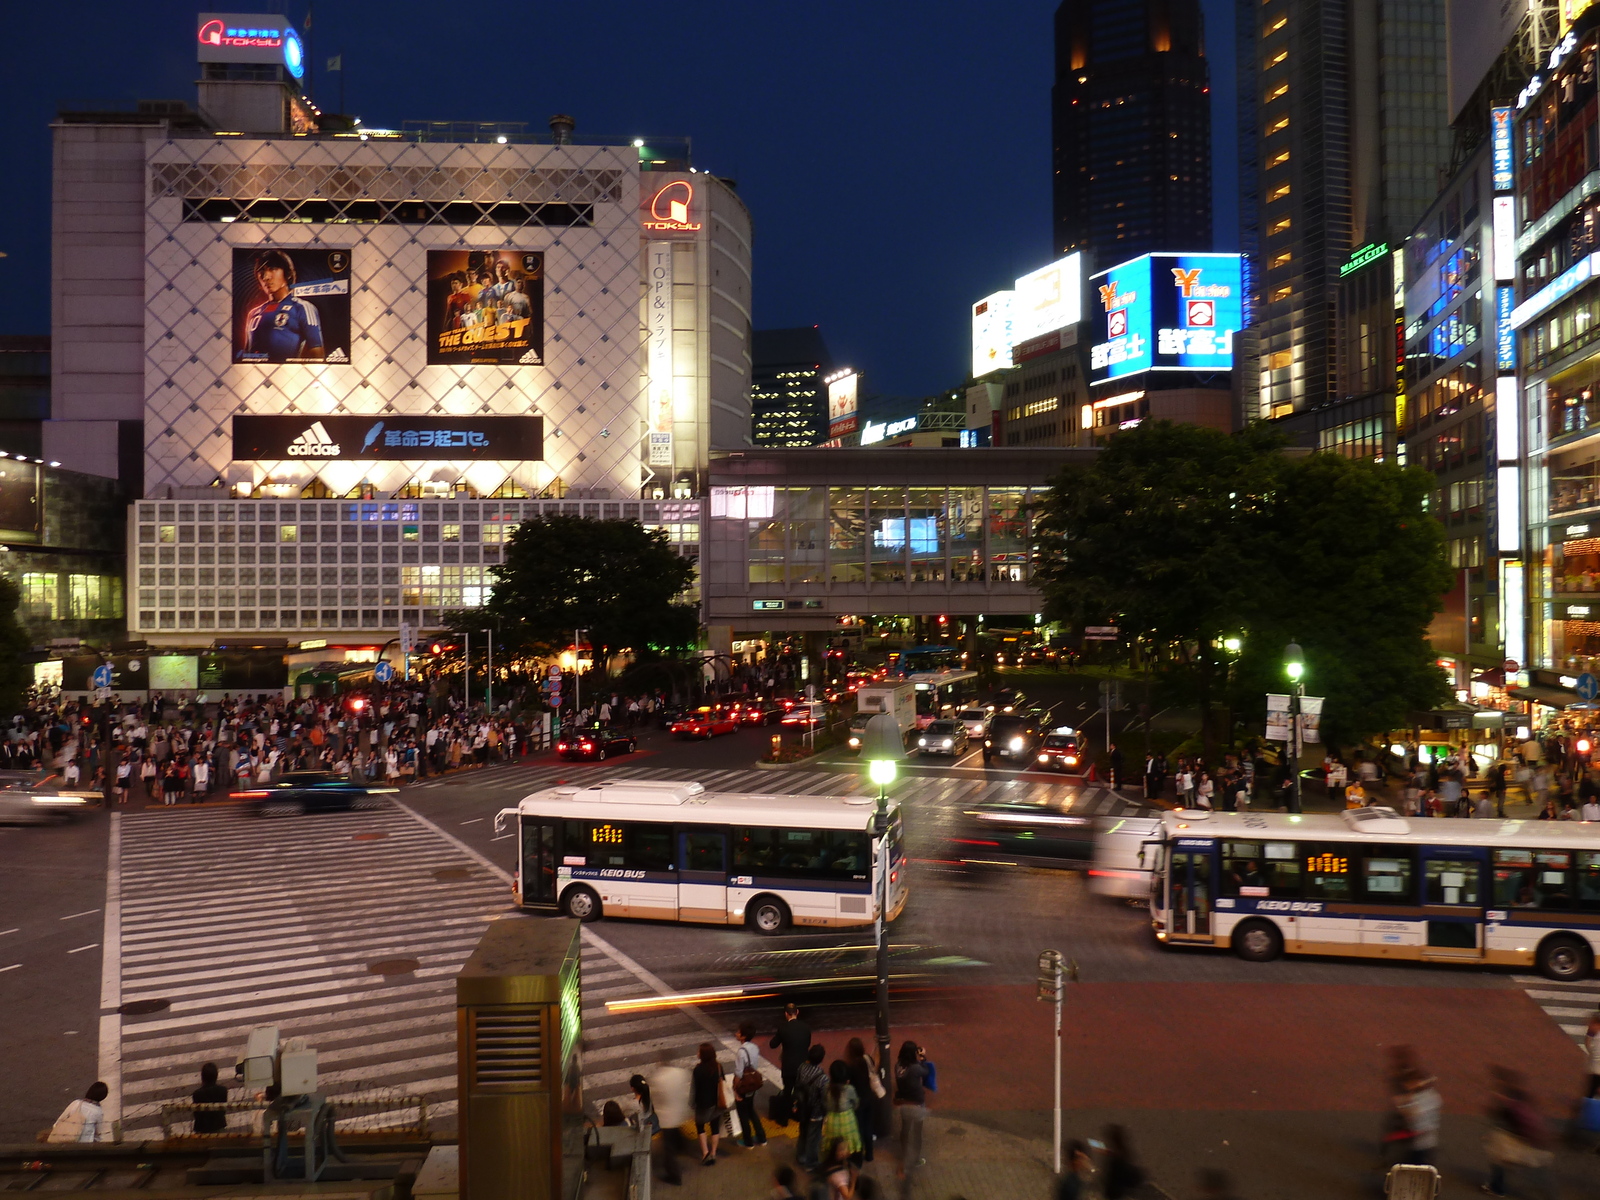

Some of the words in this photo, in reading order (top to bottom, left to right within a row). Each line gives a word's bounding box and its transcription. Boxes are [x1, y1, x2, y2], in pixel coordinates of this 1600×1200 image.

[221, 38, 281, 46] TOKYU
[643, 222, 701, 230] TOKYU
[1340, 256, 1365, 274] MARK
[1365, 243, 1388, 260] CITY
[439, 334, 461, 347] THE
[462, 318, 531, 344] QUEST
[1499, 360, 1513, 369] 5F
[384, 430, 489, 447] 革命ヲ起コセ。
[287, 443, 340, 456] adidas
[599, 868, 624, 878] KEIO
[624, 869, 646, 879] BUS
[1256, 901, 1291, 911] KEIO
[1291, 902, 1323, 912] BUS
